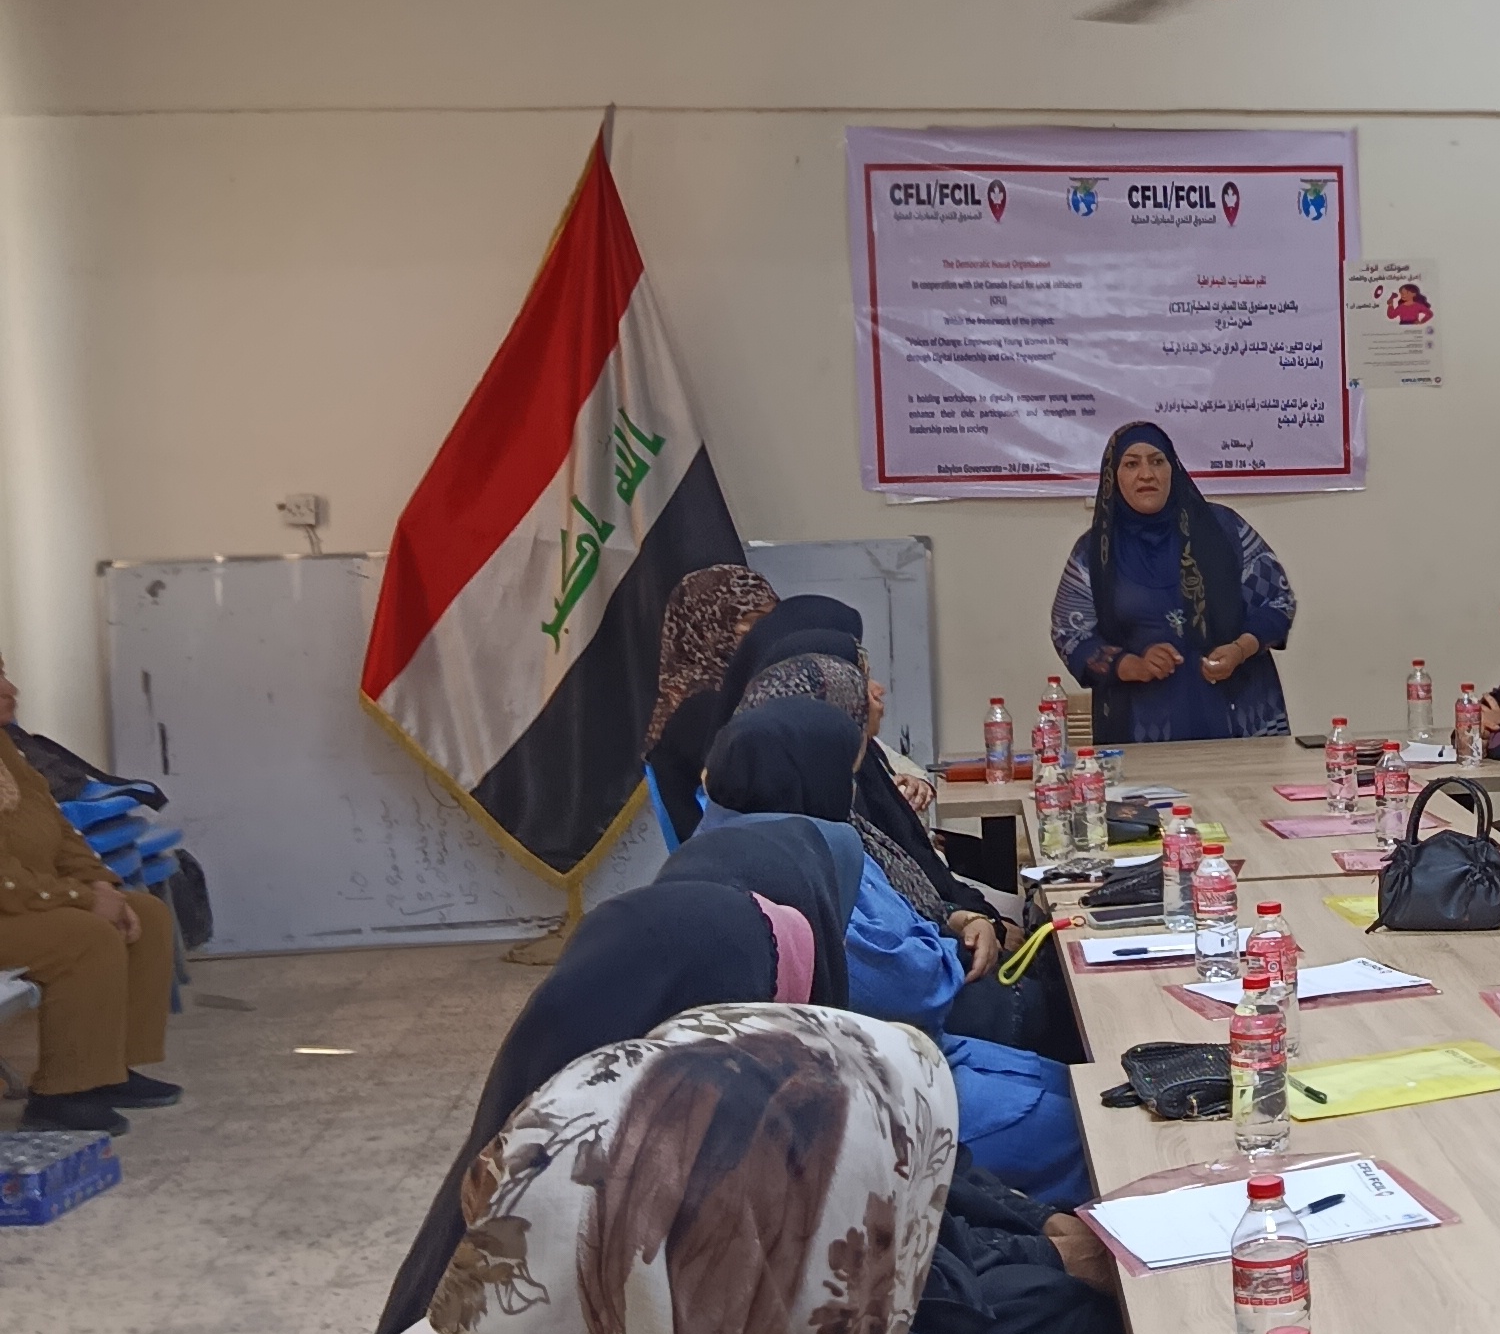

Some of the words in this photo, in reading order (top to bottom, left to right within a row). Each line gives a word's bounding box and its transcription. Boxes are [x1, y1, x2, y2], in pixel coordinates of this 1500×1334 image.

[889, 180, 982, 208] CFLI/FCIL
[1127, 181, 1216, 211] CFLI/FCIL
[614, 408, 667, 506] الله
[1357, 1162, 1386, 1191] CFLIFCIL
